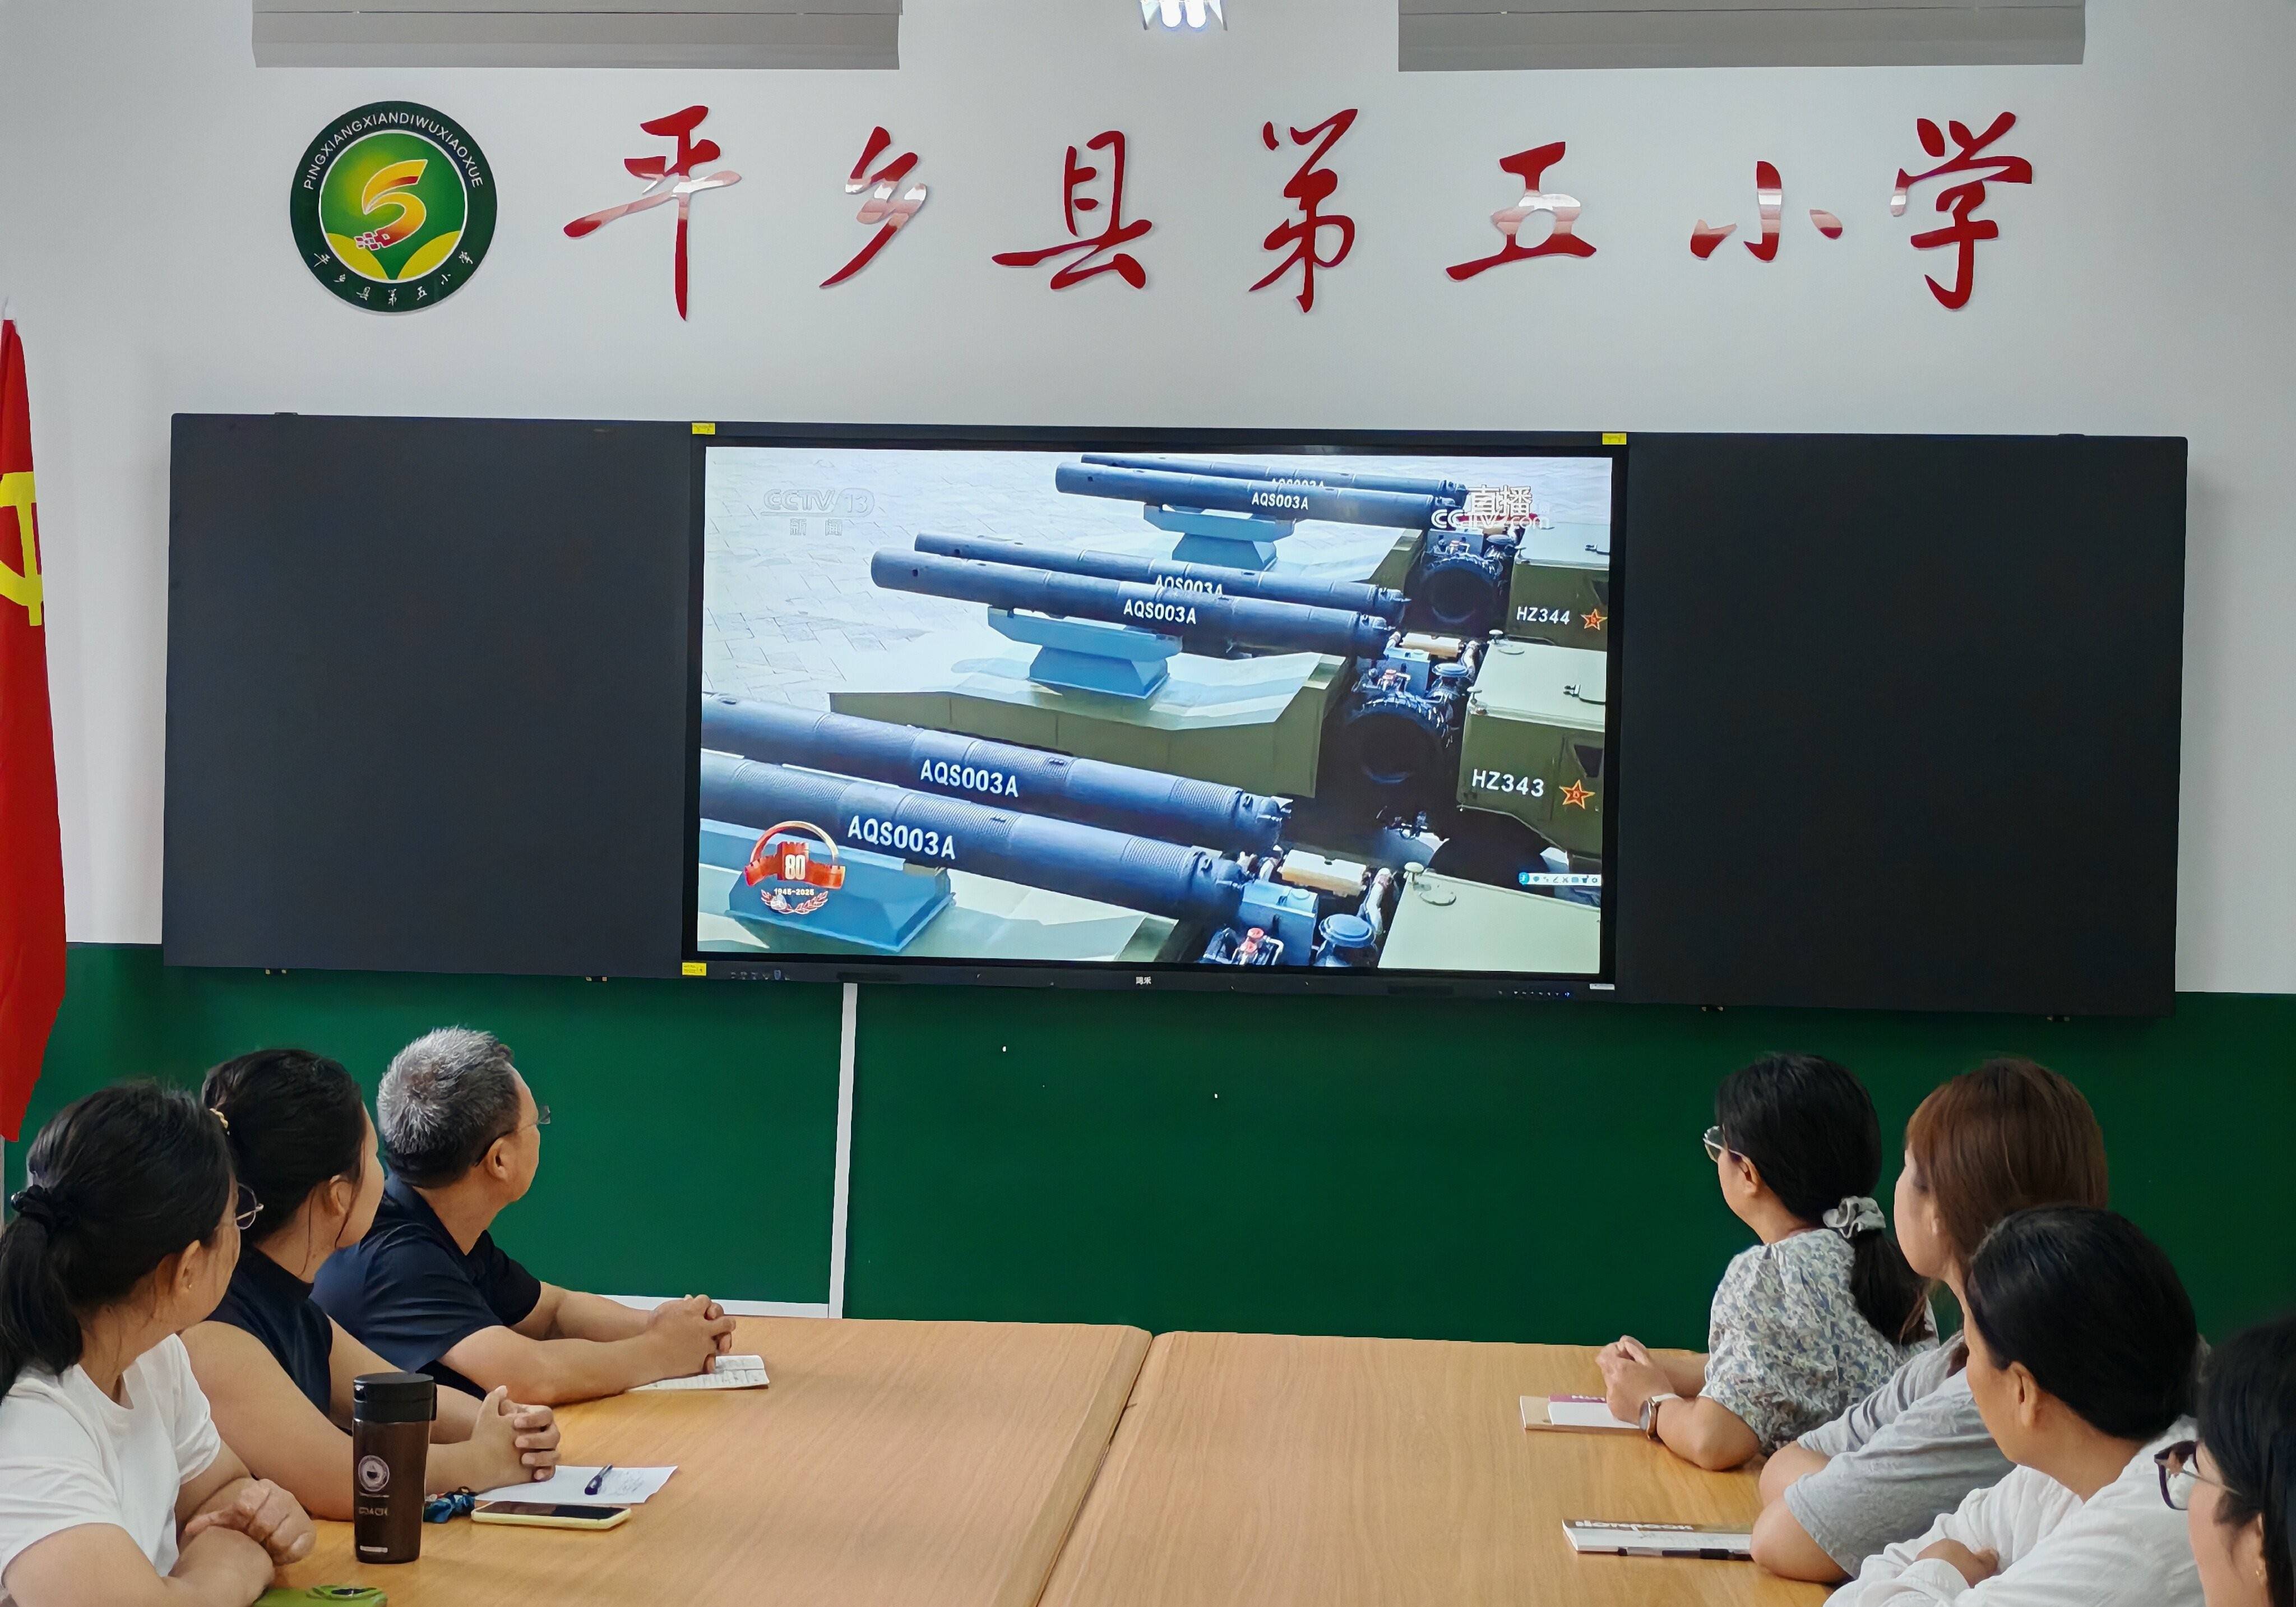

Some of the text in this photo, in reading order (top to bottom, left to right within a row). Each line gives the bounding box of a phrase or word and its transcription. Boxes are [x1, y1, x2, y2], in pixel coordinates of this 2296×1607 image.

[303, 112, 483, 190] PINGXIANGXIANDIWUXIAOXUE
[563, 105, 2034, 320] 平乡县第五小学
[763, 488, 836, 511] CCTV
[1251, 492, 1309, 510] AQS003A
[1468, 484, 1533, 517] 直播
[1123, 598, 1197, 625] AQS003A
[1516, 606, 1570, 625] HZ344
[920, 759, 1019, 797] AQS003A
[1471, 768, 1544, 797] HZ343
[848, 815, 956, 860] AQS003A
[785, 854, 806, 880] 80
[774, 888, 815, 896] 1945-2025
